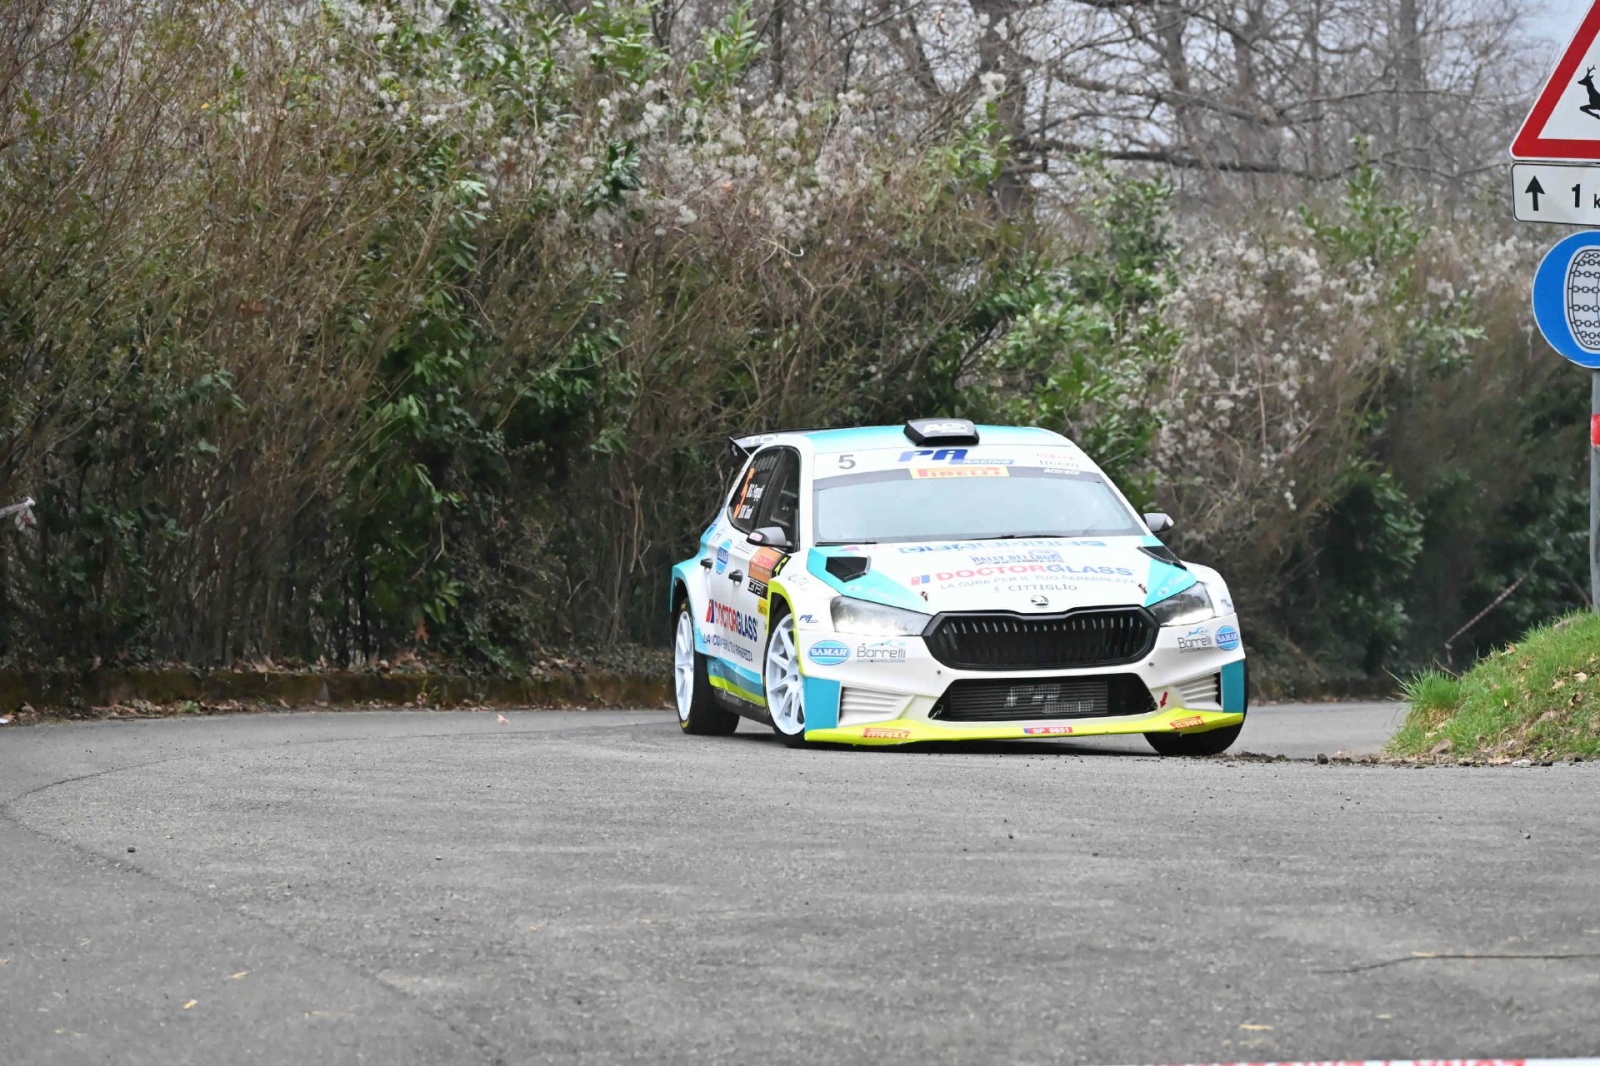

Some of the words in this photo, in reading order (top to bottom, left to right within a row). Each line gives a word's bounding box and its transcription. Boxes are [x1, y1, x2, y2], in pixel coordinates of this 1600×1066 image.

[1571, 183, 1580, 208] 1
[838, 454, 856, 470] 5
[917, 467, 1001, 479] PIRELLI
[733, 467, 756, 520] 5
[935, 564, 1134, 582] DOCTORGLASS
[1007, 583, 1078, 593] CITTIGLIO
[715, 601, 758, 643] DOCTORGLASS
[809, 648, 848, 657] SAMAR
[863, 727, 911, 739] PIRELLI
